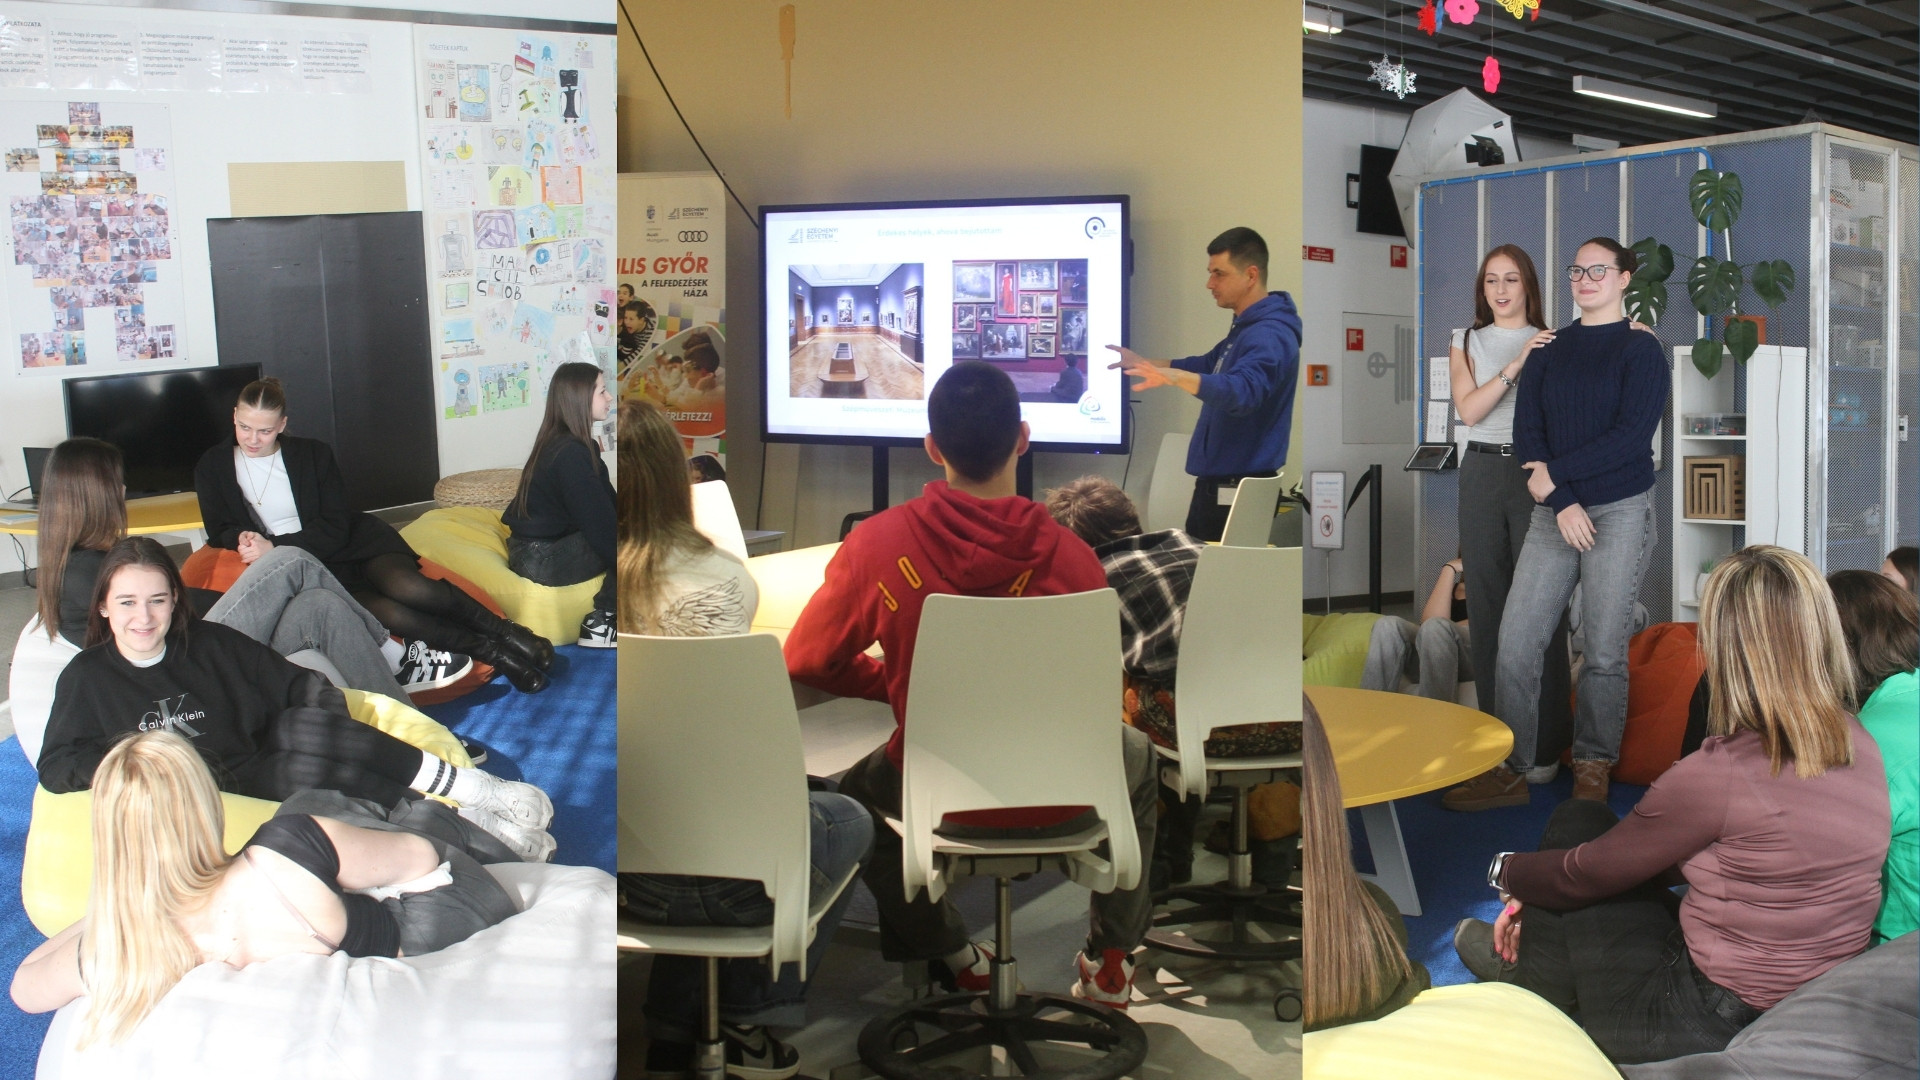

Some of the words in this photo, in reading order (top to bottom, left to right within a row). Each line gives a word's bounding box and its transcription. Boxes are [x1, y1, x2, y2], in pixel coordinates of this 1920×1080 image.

[653, 251, 709, 274] GYŐR
[650, 278, 708, 287] FELFEDEZÉSEK
[683, 288, 708, 297] HÁZA
[665, 409, 713, 421] ÉRLETEZZ!
[138, 716, 177, 732] Calvin
[177, 710, 205, 723] Klein
